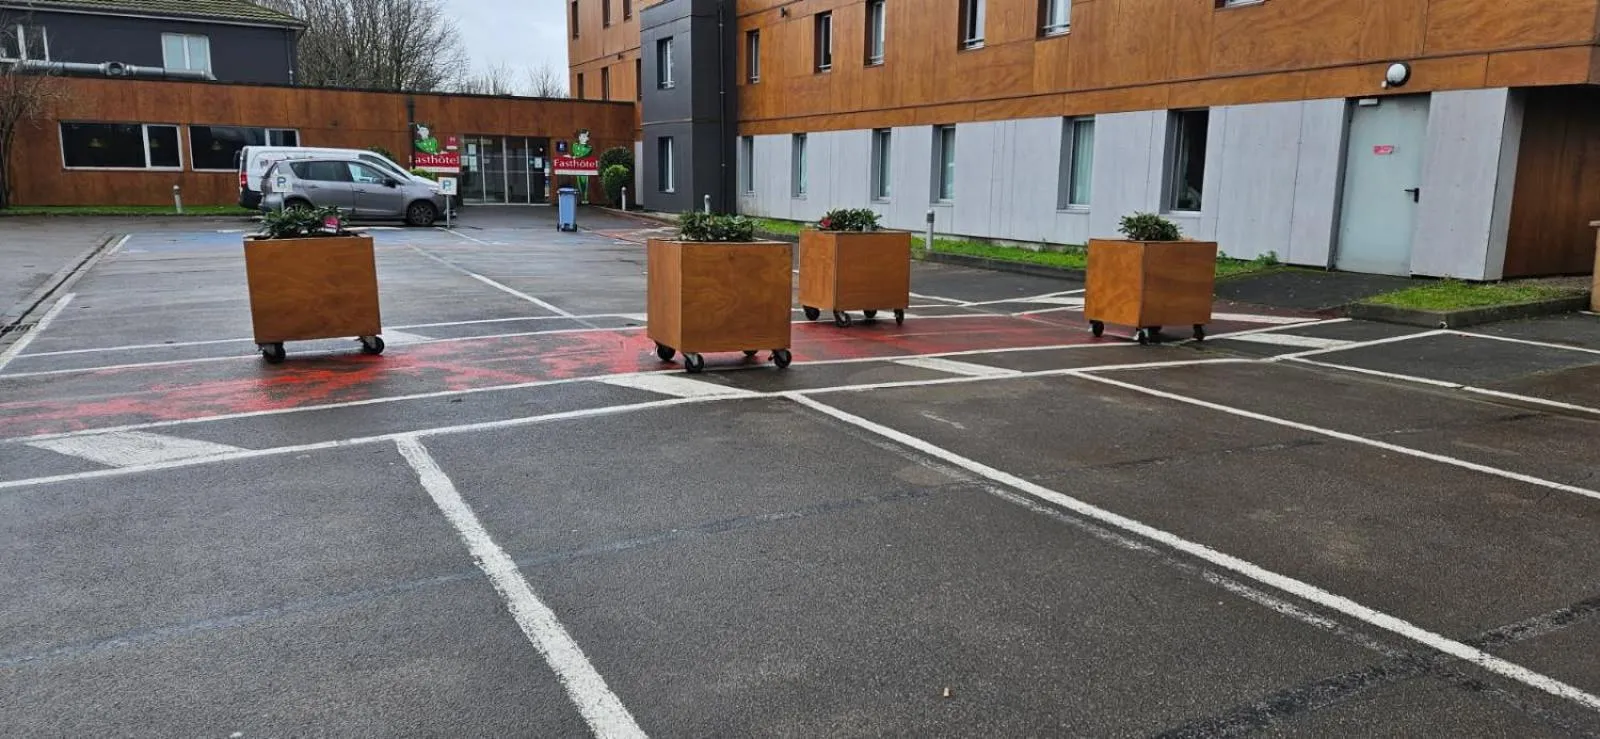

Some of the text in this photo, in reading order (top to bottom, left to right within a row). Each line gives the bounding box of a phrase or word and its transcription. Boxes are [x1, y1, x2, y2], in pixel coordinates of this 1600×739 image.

[554, 158, 598, 168] Fasthôtel
[277, 176, 286, 187] P
[443, 180, 452, 190] P
